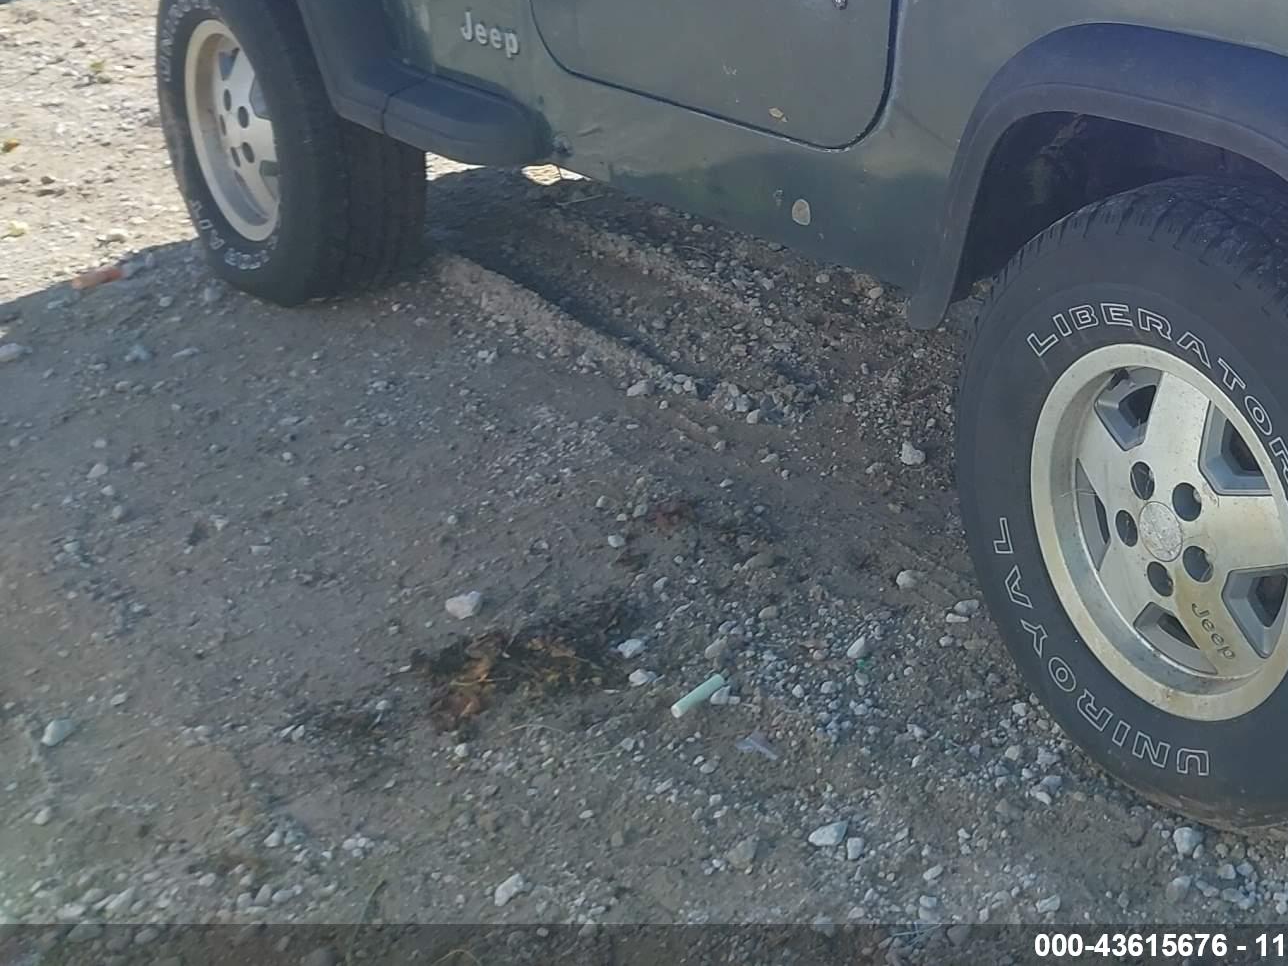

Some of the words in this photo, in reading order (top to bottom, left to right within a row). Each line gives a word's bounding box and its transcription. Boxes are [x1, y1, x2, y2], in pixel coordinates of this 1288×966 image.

[460, 10, 519, 59] Jeep
[993, 517, 1210, 777] UNIROYAL
[1191, 602, 1236, 660] Jeep
